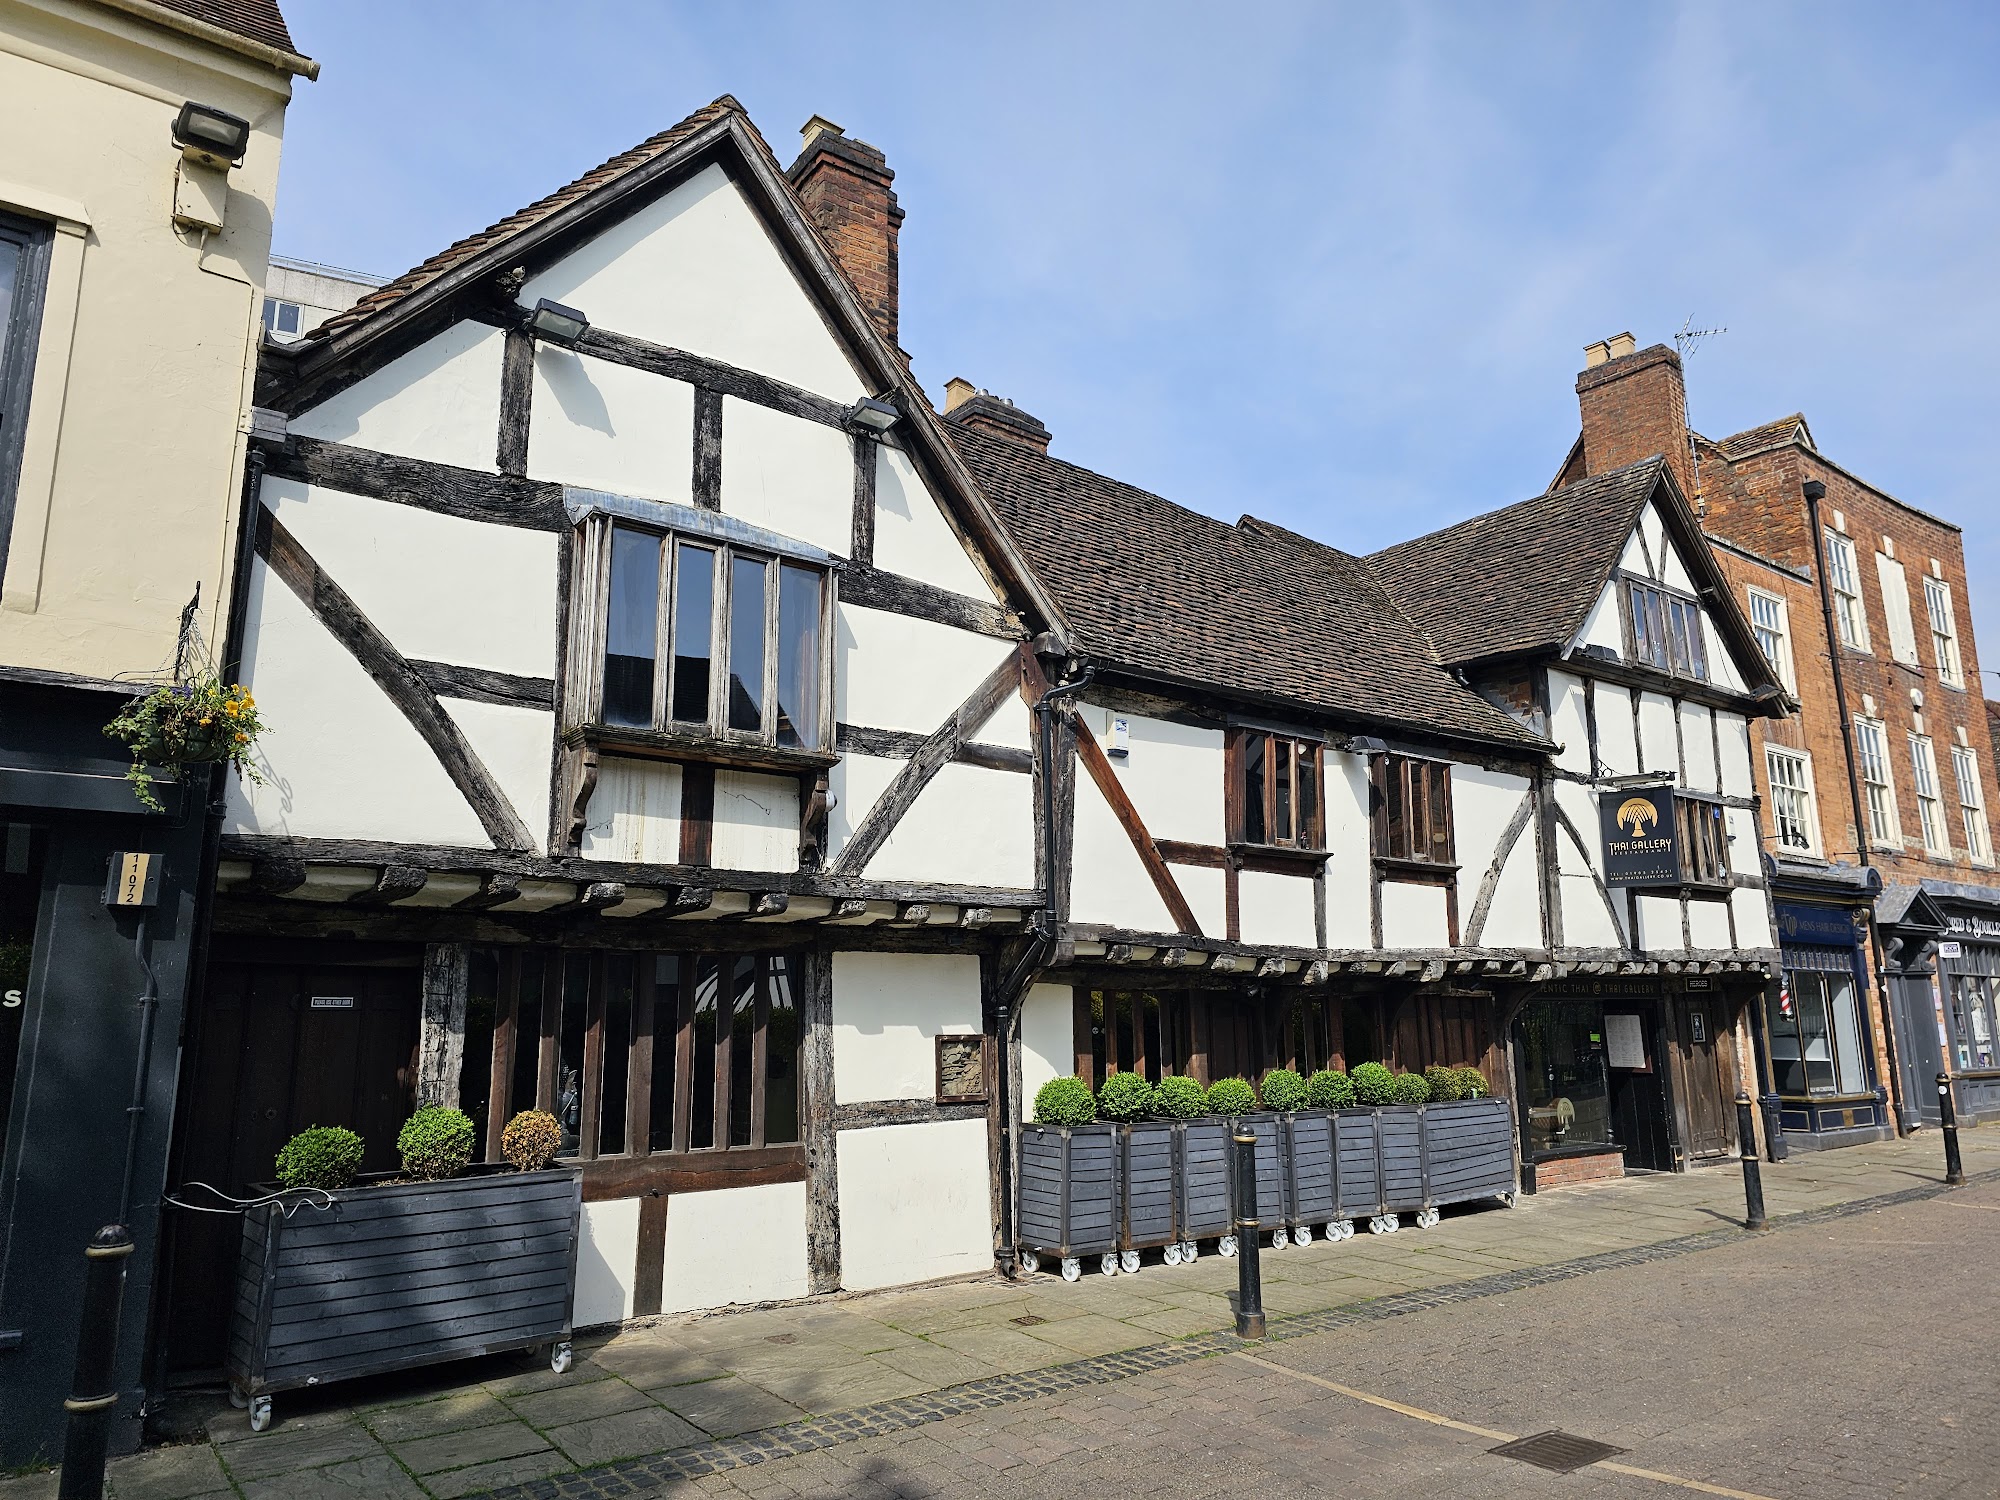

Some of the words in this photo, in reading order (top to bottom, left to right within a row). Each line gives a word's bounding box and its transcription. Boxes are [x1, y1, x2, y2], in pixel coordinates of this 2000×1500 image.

[1609, 841, 1629, 855] THAI
[1631, 839, 1671, 852] GALLERY
[126, 854, 138, 902] 11072
